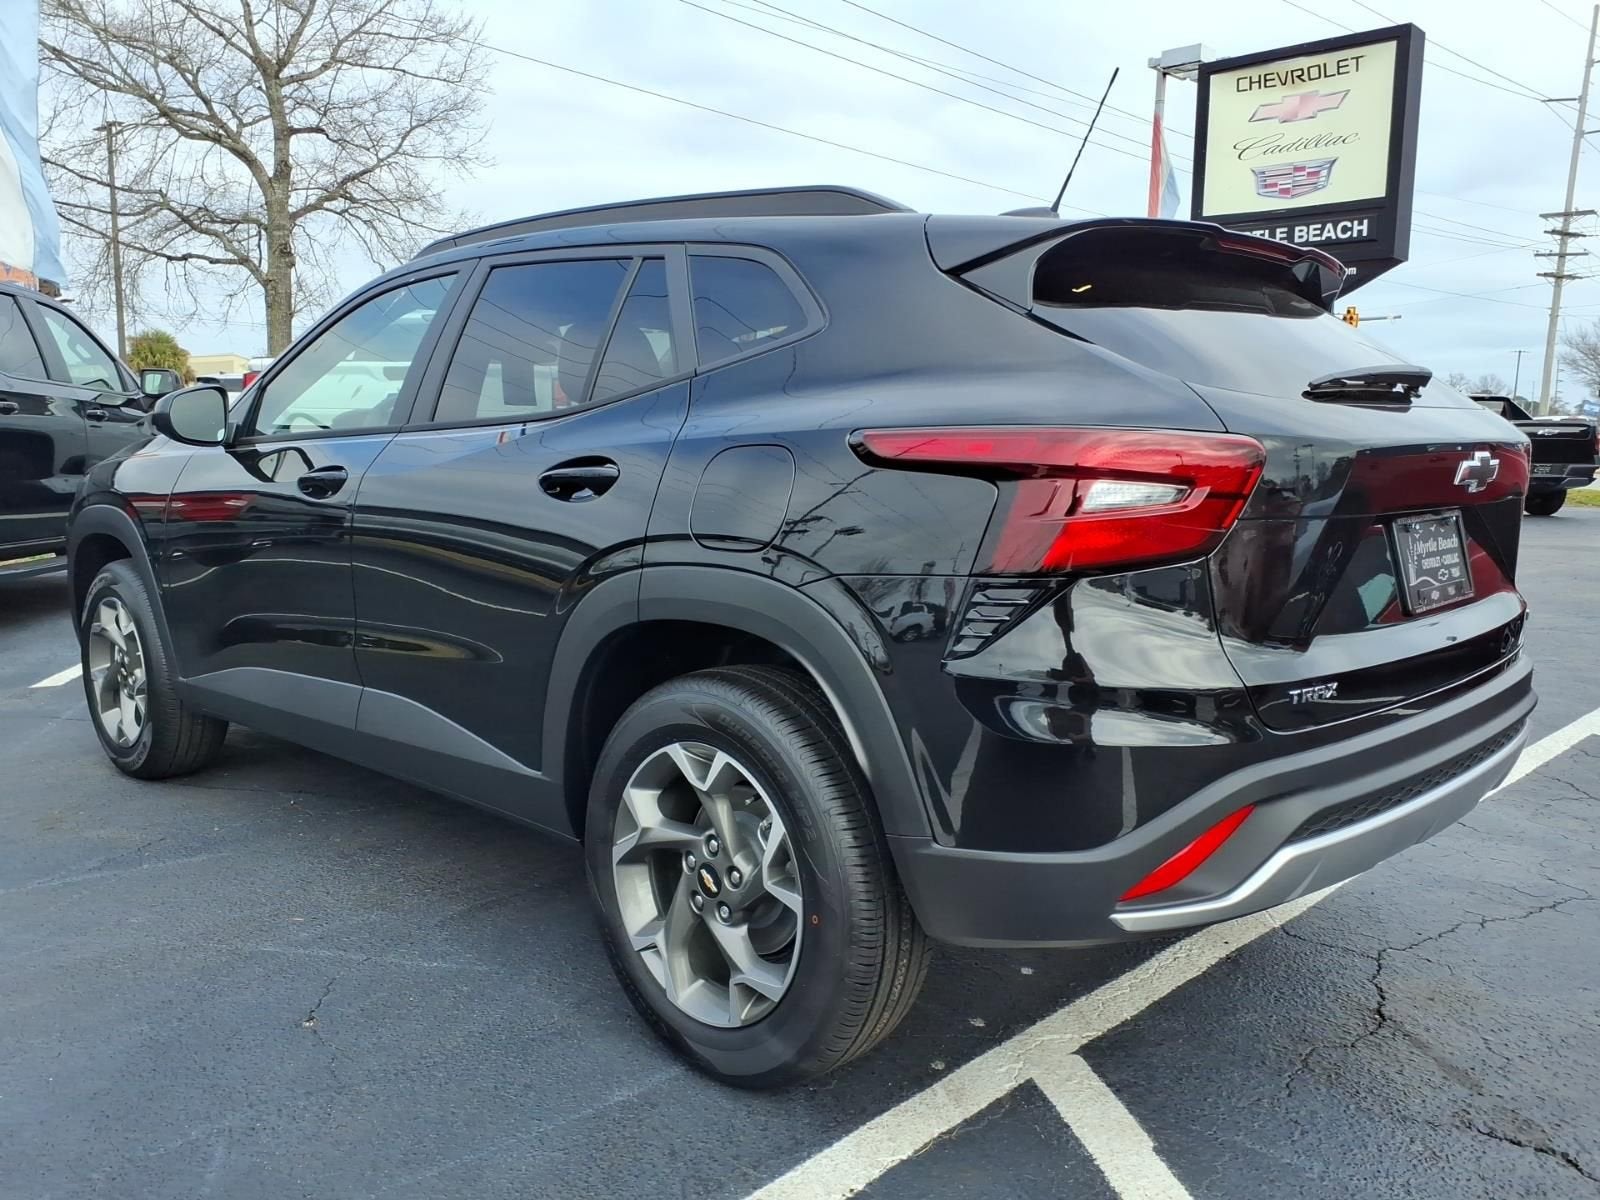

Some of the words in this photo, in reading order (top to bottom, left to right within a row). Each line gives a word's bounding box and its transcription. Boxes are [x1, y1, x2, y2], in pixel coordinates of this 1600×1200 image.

[1236, 55, 1366, 93] CHEVROLET
[1233, 132, 1360, 160] Cadillac
[1294, 219, 1368, 243] BEACH
[1416, 537, 1437, 557] Myrtle
[1438, 533, 1458, 550] Beach
[1289, 681, 1338, 704] TRAX
